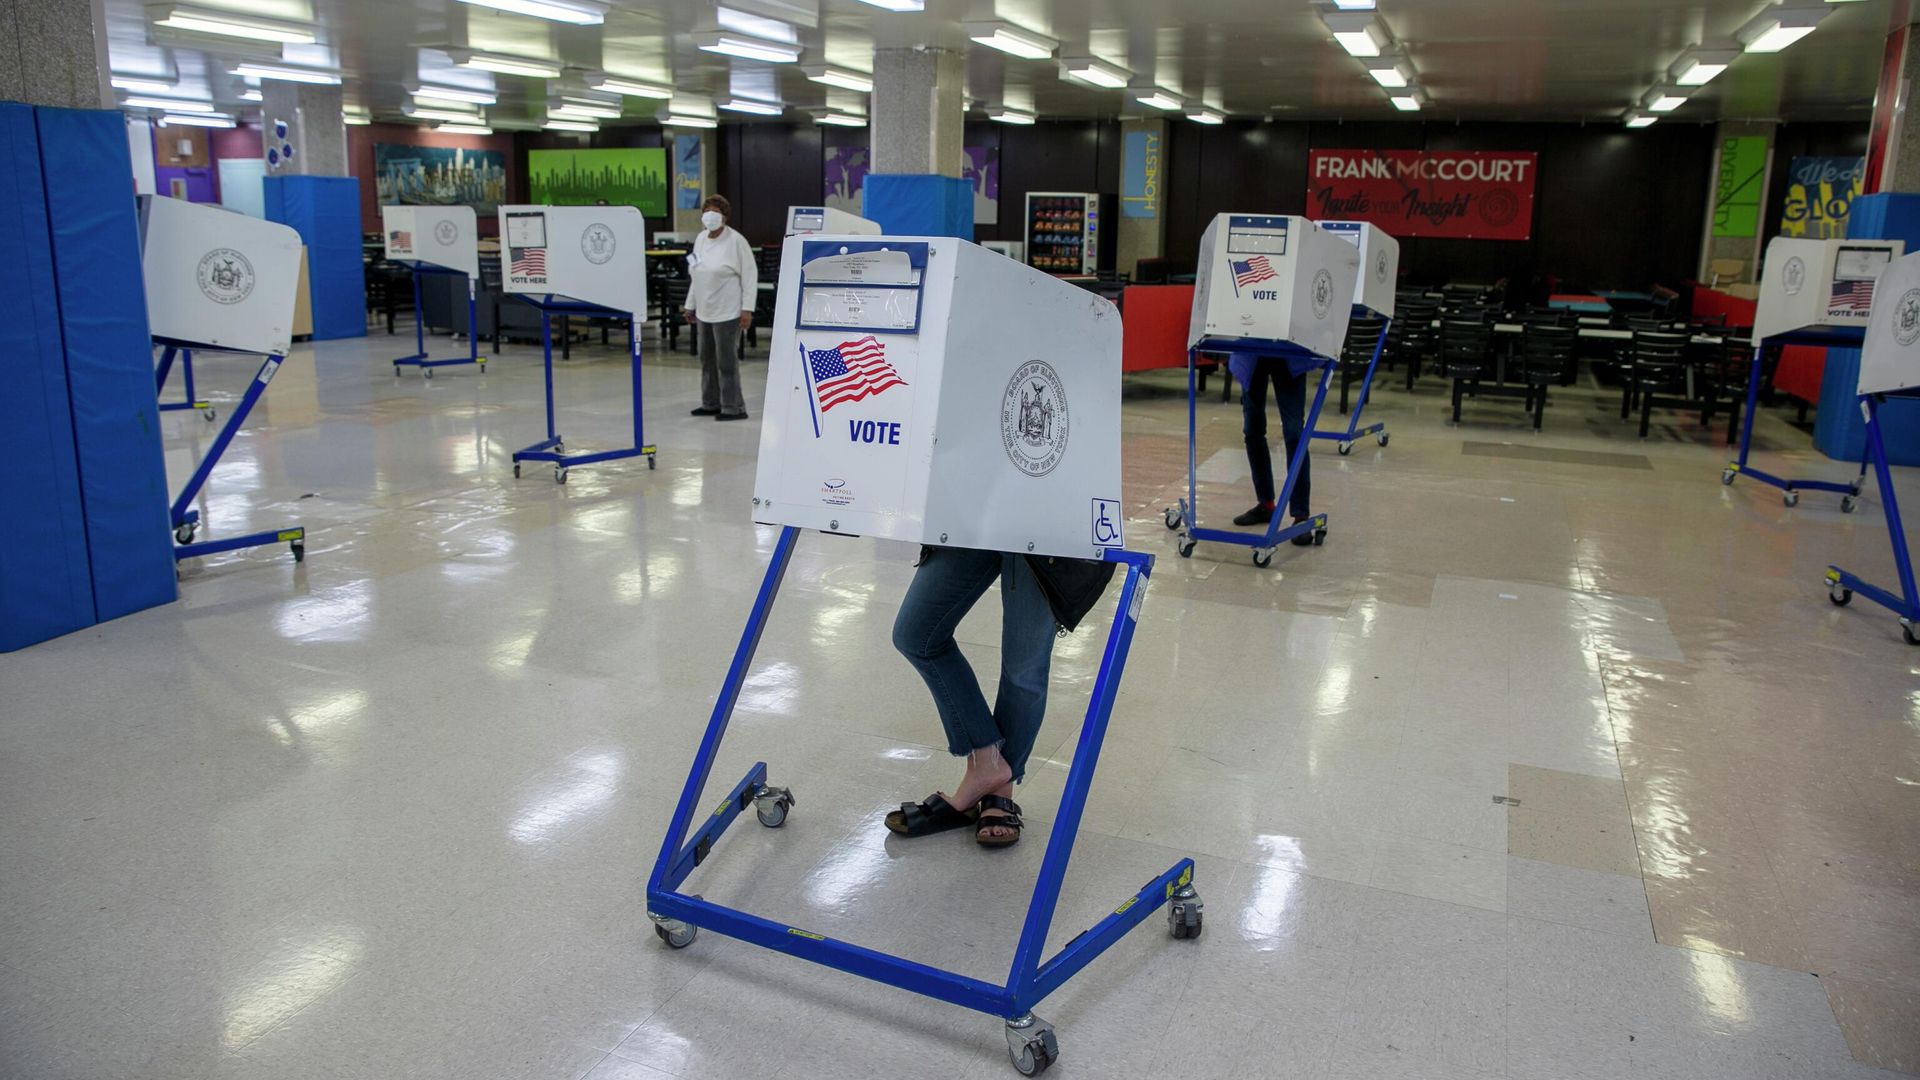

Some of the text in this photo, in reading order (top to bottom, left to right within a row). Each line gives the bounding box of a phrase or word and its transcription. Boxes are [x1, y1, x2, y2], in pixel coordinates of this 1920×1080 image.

[1315, 157, 1531, 182] FRANK MCCOURT
[1713, 138, 1738, 231] DIVERSITY
[1783, 198, 1850, 221] GLO
[1252, 290, 1278, 301] VOTE
[849, 420, 901, 445] VOTE
